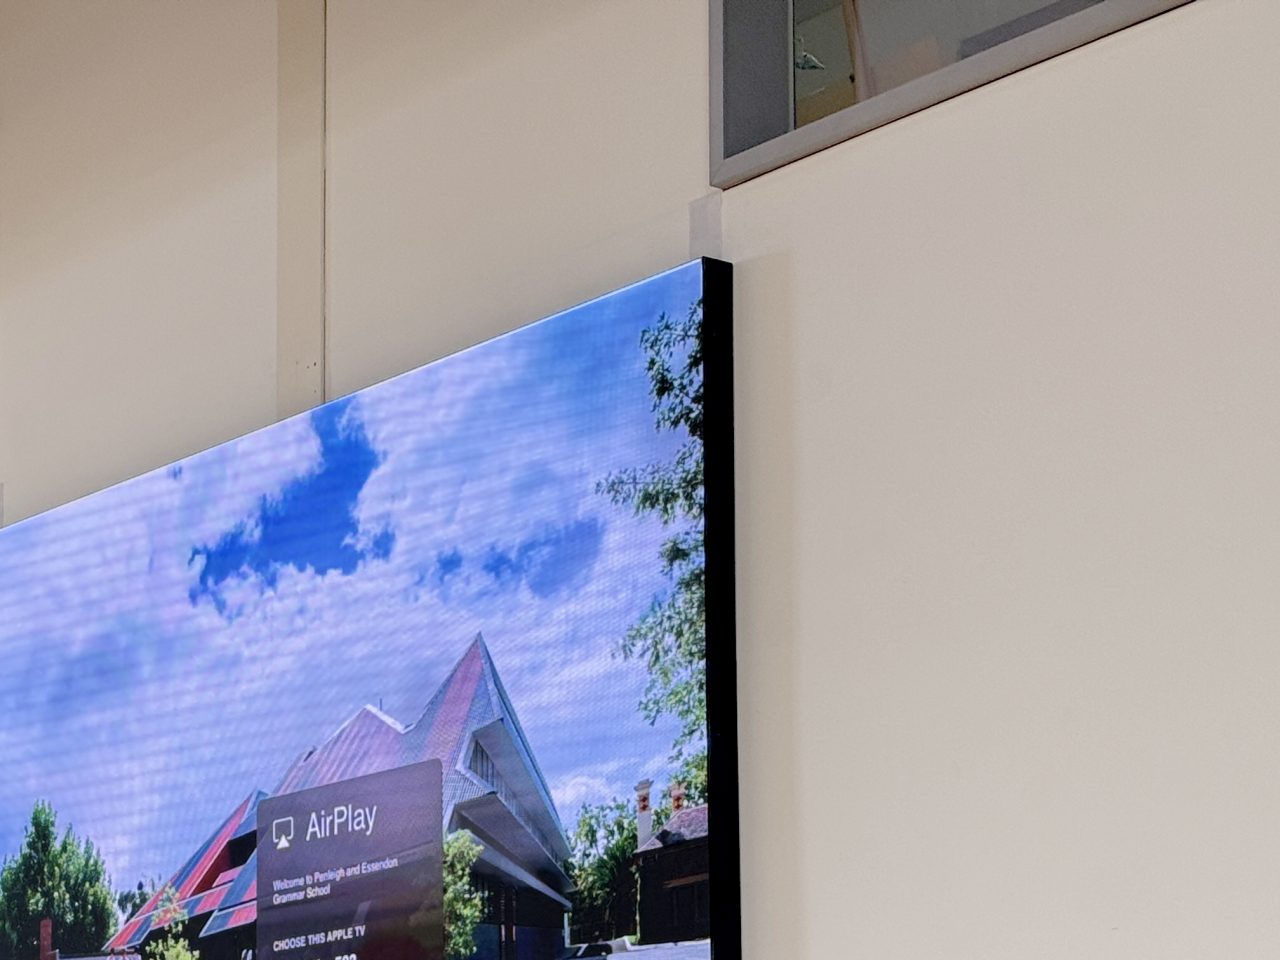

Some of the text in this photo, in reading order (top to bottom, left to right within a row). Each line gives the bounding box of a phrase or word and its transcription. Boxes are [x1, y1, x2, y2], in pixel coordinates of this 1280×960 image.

[305, 803, 377, 842] AirPlay
[272, 857, 399, 892] Welcome to Penleigh and Essendon
[272, 884, 331, 905] Grammar School
[273, 925, 367, 952] CHOOSE THIS APPLE TV
